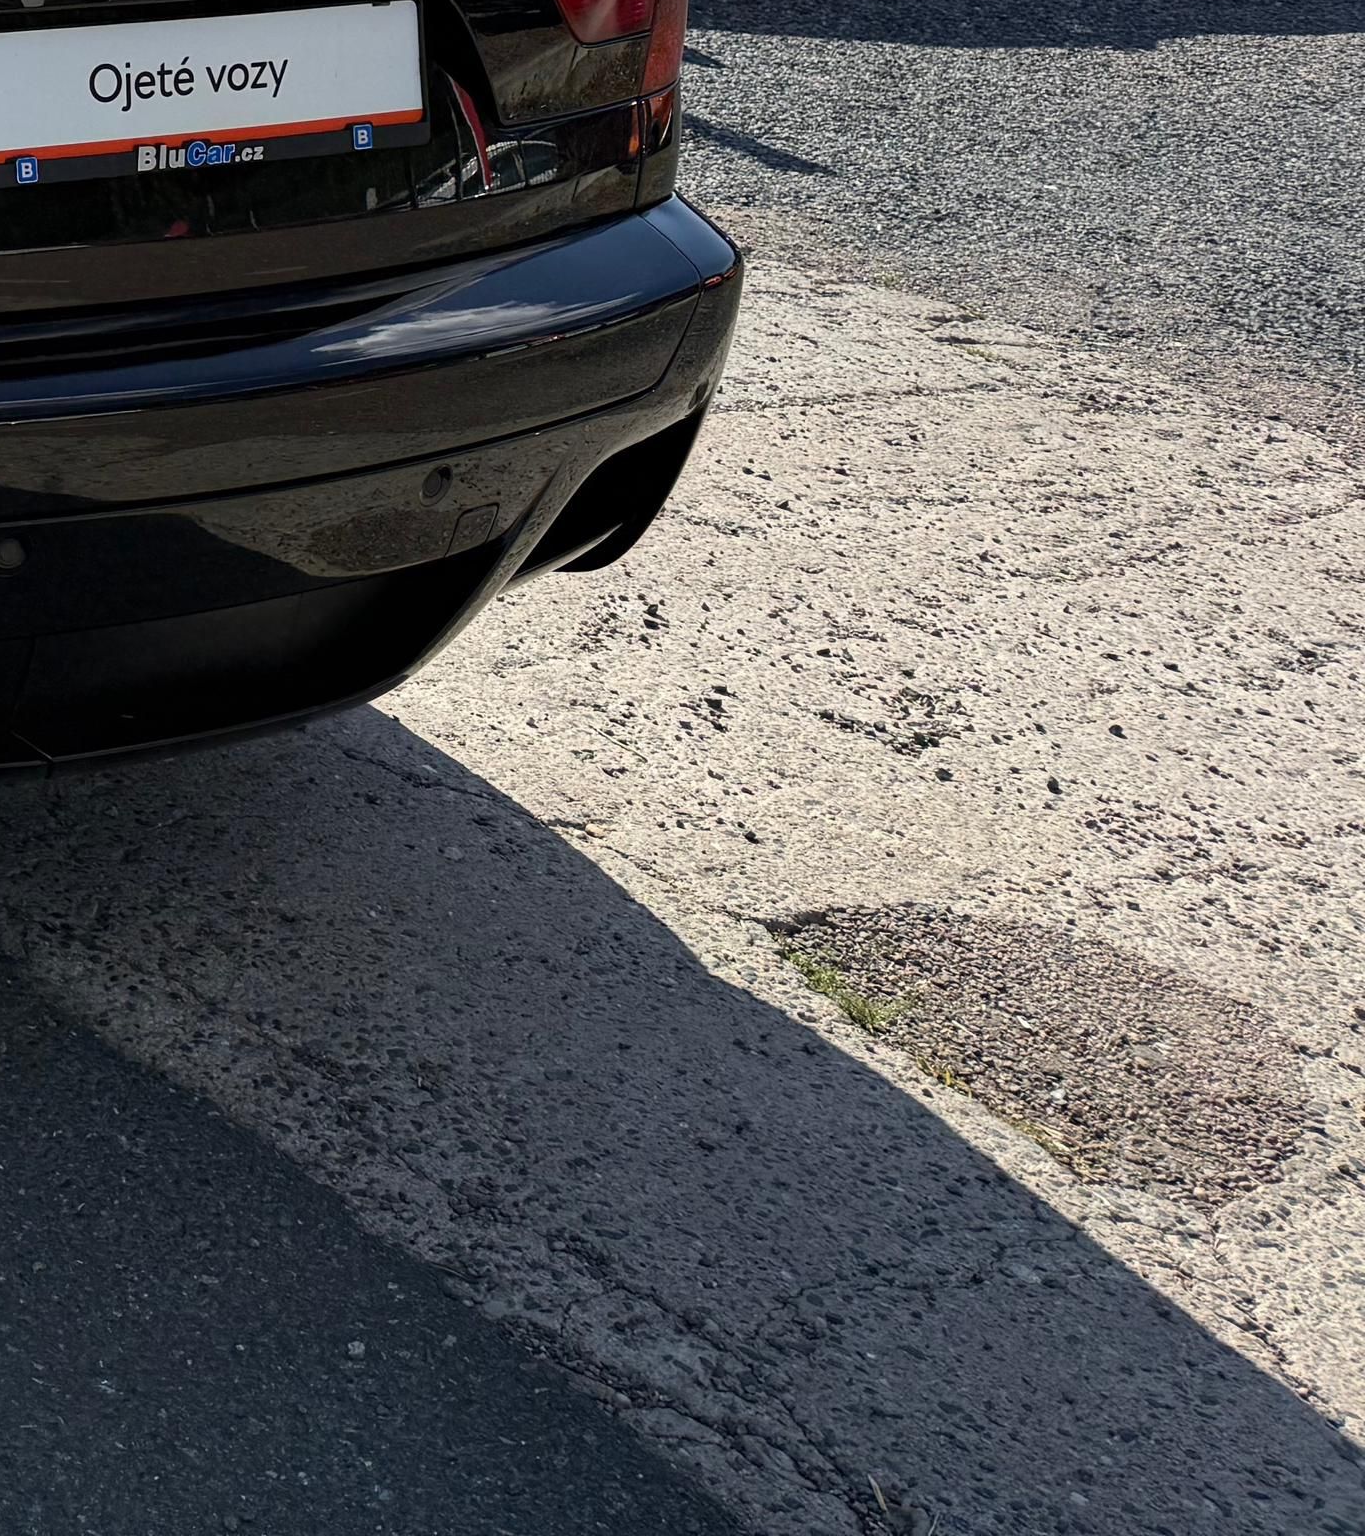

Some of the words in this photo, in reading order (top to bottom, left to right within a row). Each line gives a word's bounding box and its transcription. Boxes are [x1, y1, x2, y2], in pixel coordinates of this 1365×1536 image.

[89, 56, 195, 112] Ojeté
[205, 59, 289, 98] vozy
[137, 141, 265, 172] BluCar.cz
